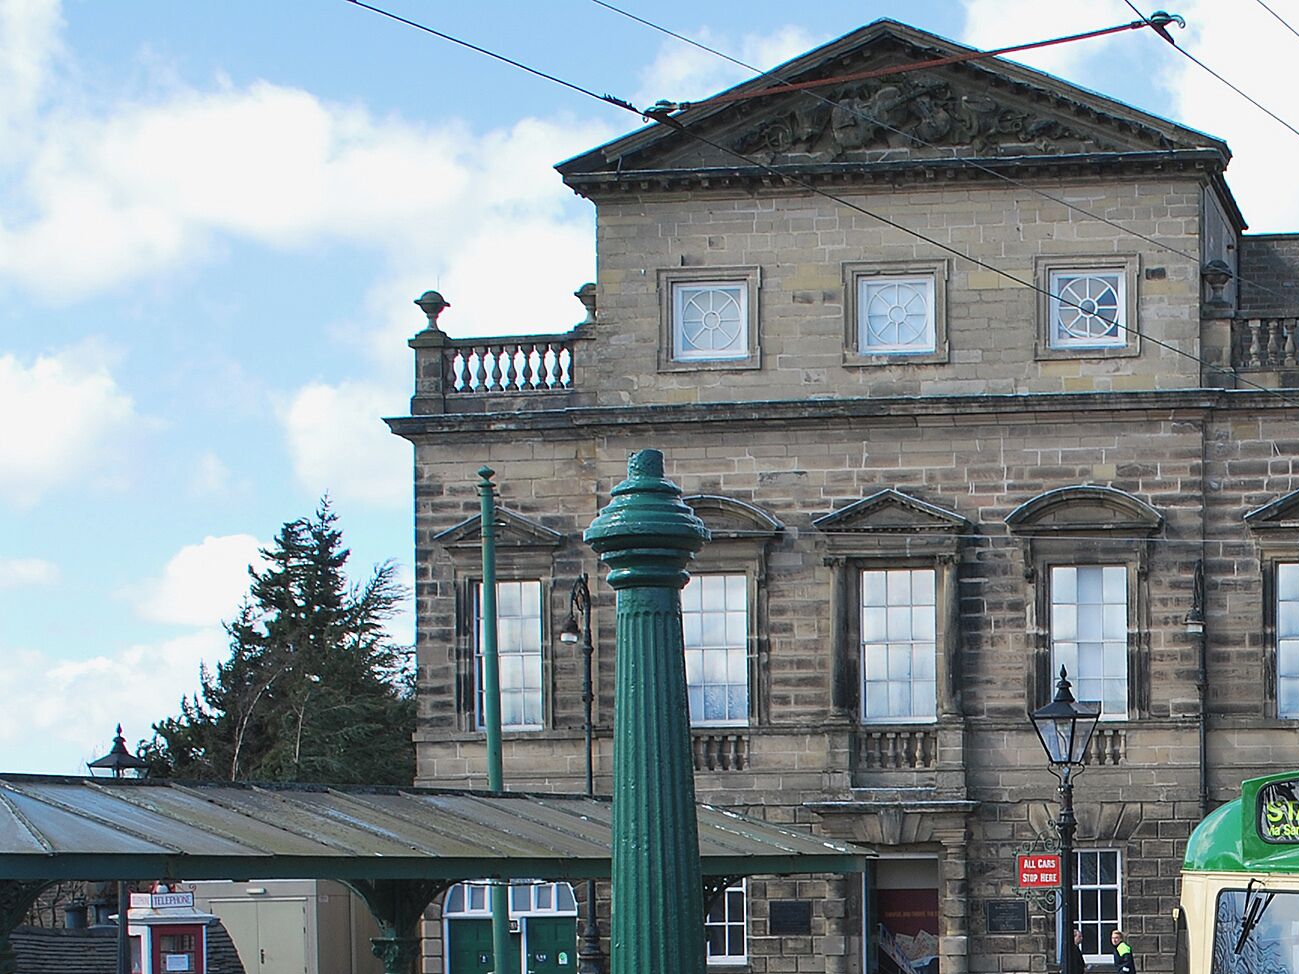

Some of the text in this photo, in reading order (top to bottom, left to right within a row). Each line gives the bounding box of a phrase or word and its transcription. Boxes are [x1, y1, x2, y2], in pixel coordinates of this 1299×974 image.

[1023, 859, 1056, 869] ALL CARS
[1022, 873, 1058, 883] STOP HERE
[153, 895, 192, 906] TELEPHONE
